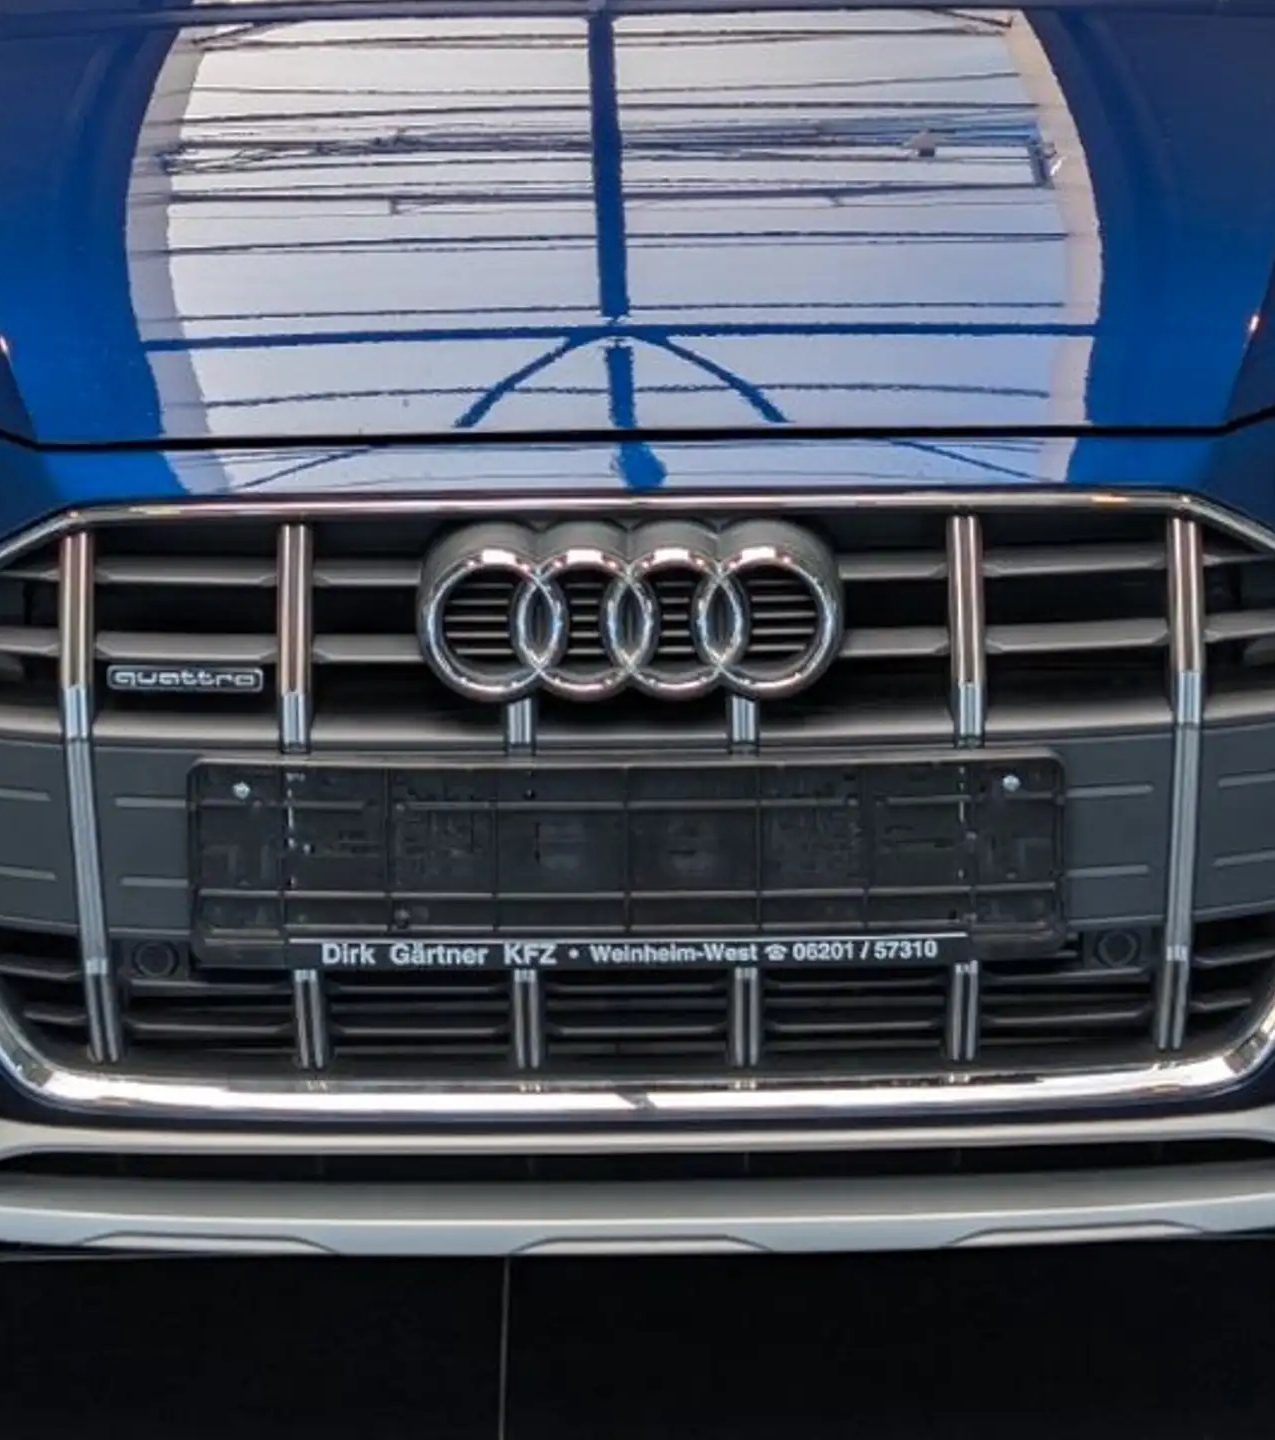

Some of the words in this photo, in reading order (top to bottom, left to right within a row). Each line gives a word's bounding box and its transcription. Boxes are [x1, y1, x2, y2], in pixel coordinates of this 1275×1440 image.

[114, 670, 256, 687] quattro
[321, 943, 377, 965] Dirk
[389, 942, 489, 965] Gärtner
[503, 943, 558, 965] KFZ
[589, 943, 759, 963] Weinheim-West
[792, 942, 854, 961] 06201
[873, 940, 938, 960] 57310
